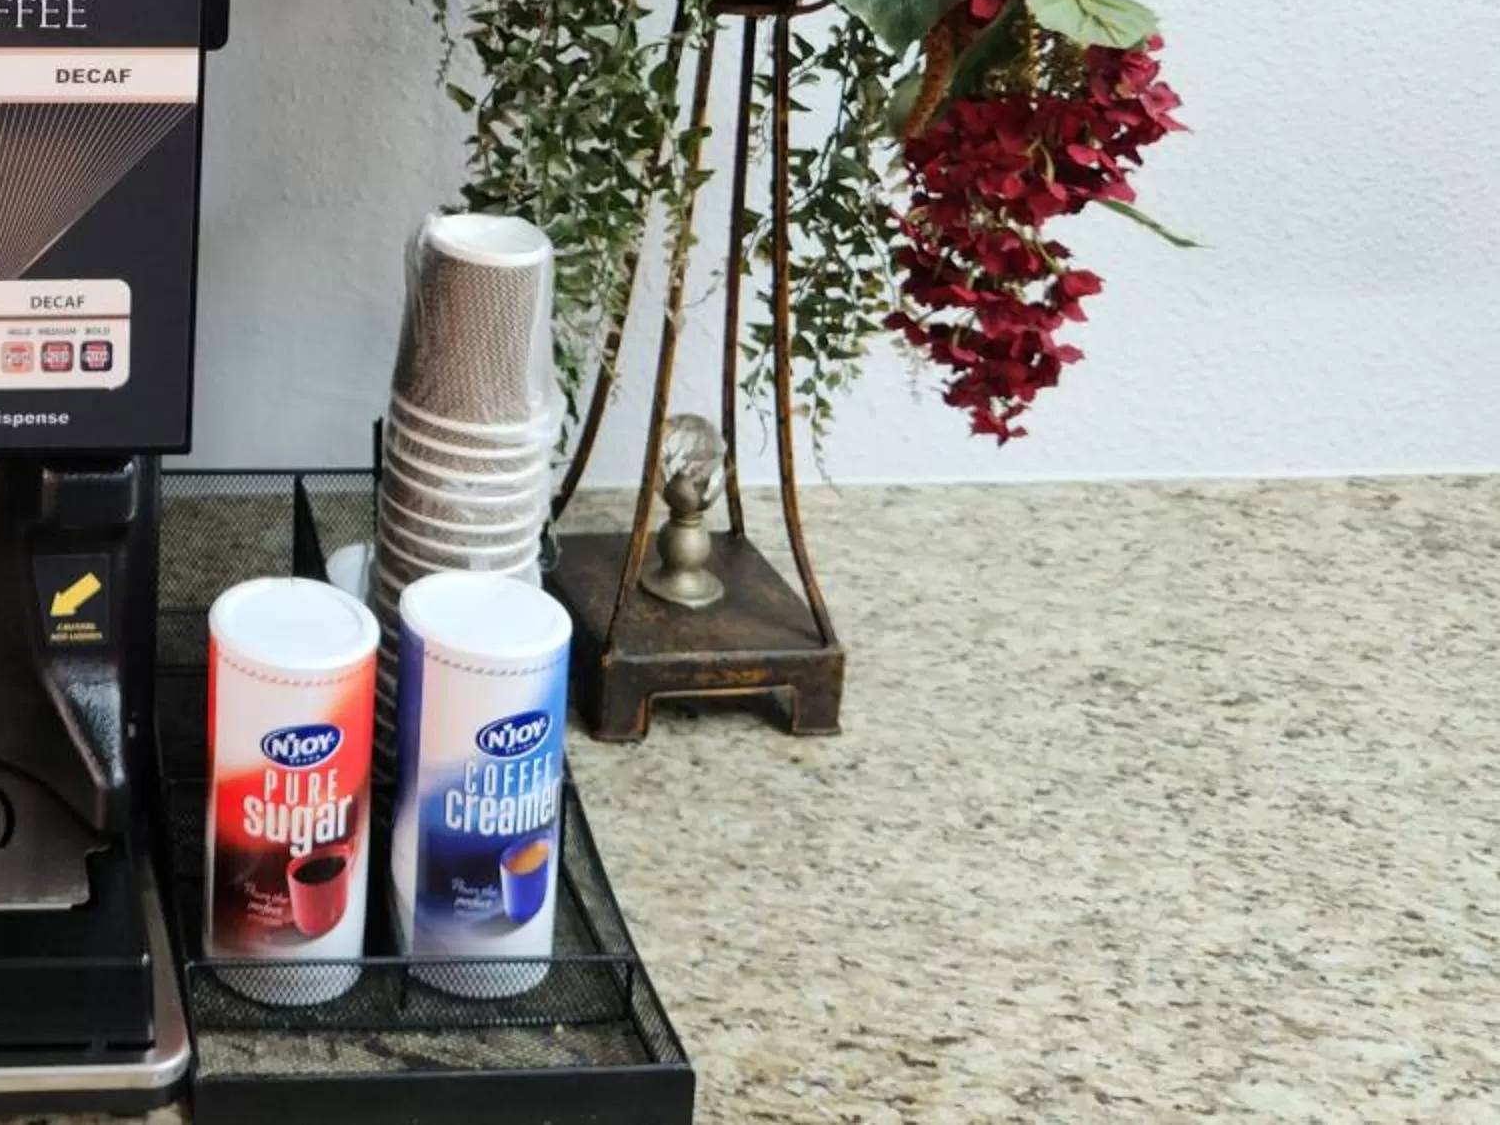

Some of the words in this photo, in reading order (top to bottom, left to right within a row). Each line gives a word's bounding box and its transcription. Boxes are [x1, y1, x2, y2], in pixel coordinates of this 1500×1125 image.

[54, 68, 133, 85] DECAF
[30, 295, 86, 310] DECAF
[263, 767, 339, 806] PURE
